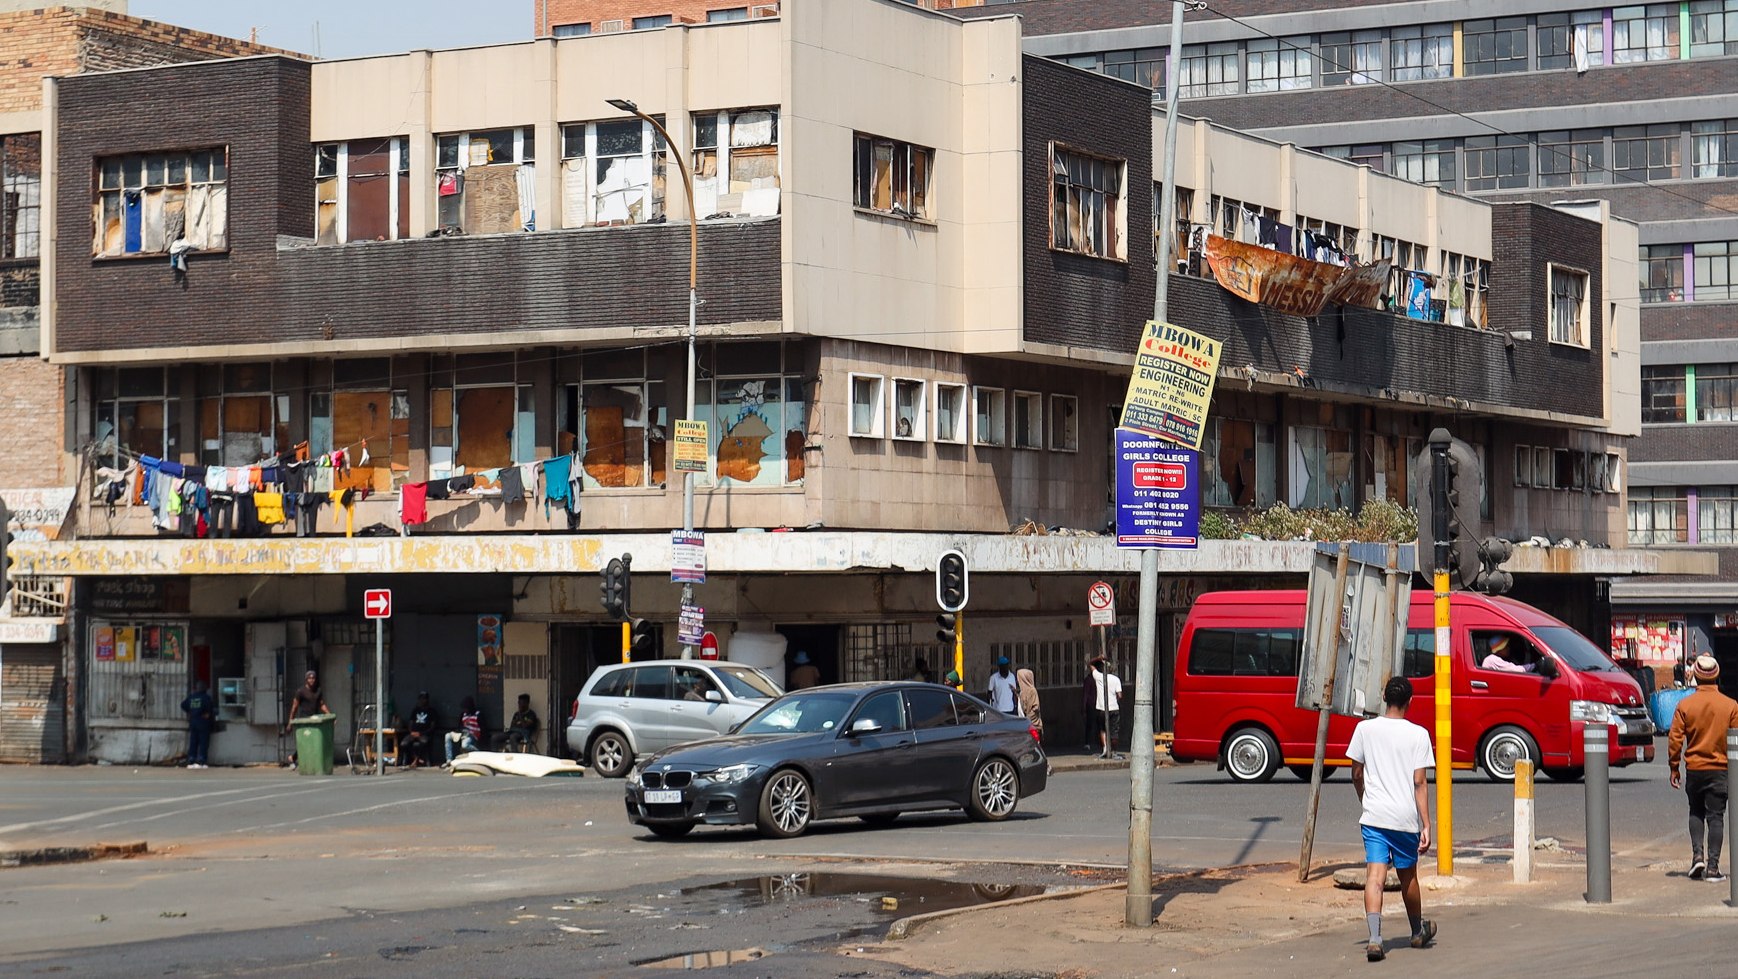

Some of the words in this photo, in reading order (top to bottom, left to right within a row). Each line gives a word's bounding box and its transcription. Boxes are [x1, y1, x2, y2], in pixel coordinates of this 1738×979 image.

[1148, 324, 1214, 357] MBOWA
[1145, 338, 1211, 368] College
[1140, 355, 1188, 377] REGISTER
[1188, 367, 1210, 385] NOW
[1139, 368, 1206, 397] ENGINEERING
[1160, 384, 1170, 392] N1
[1135, 387, 1167, 399] MATRIC
[1169, 394, 1203, 413] RE-WRITE
[1133, 396, 1159, 407] ADULT
[1160, 403, 1188, 417] MATRIC
[1192, 414, 1202, 423] SC
[1126, 410, 1136, 419] 011
[1137, 412, 1148, 421] 333
[1148, 415, 1164, 425] 6479
[1165, 419, 1176, 429] 078
[678, 421, 706, 431] MBOWA
[1123, 452, 1151, 460] GIRLS
[1152, 454, 1190, 462] COLLEGE
[673, 530, 704, 540] MBOWA
[1145, 528, 1173, 536] COLLEGE
